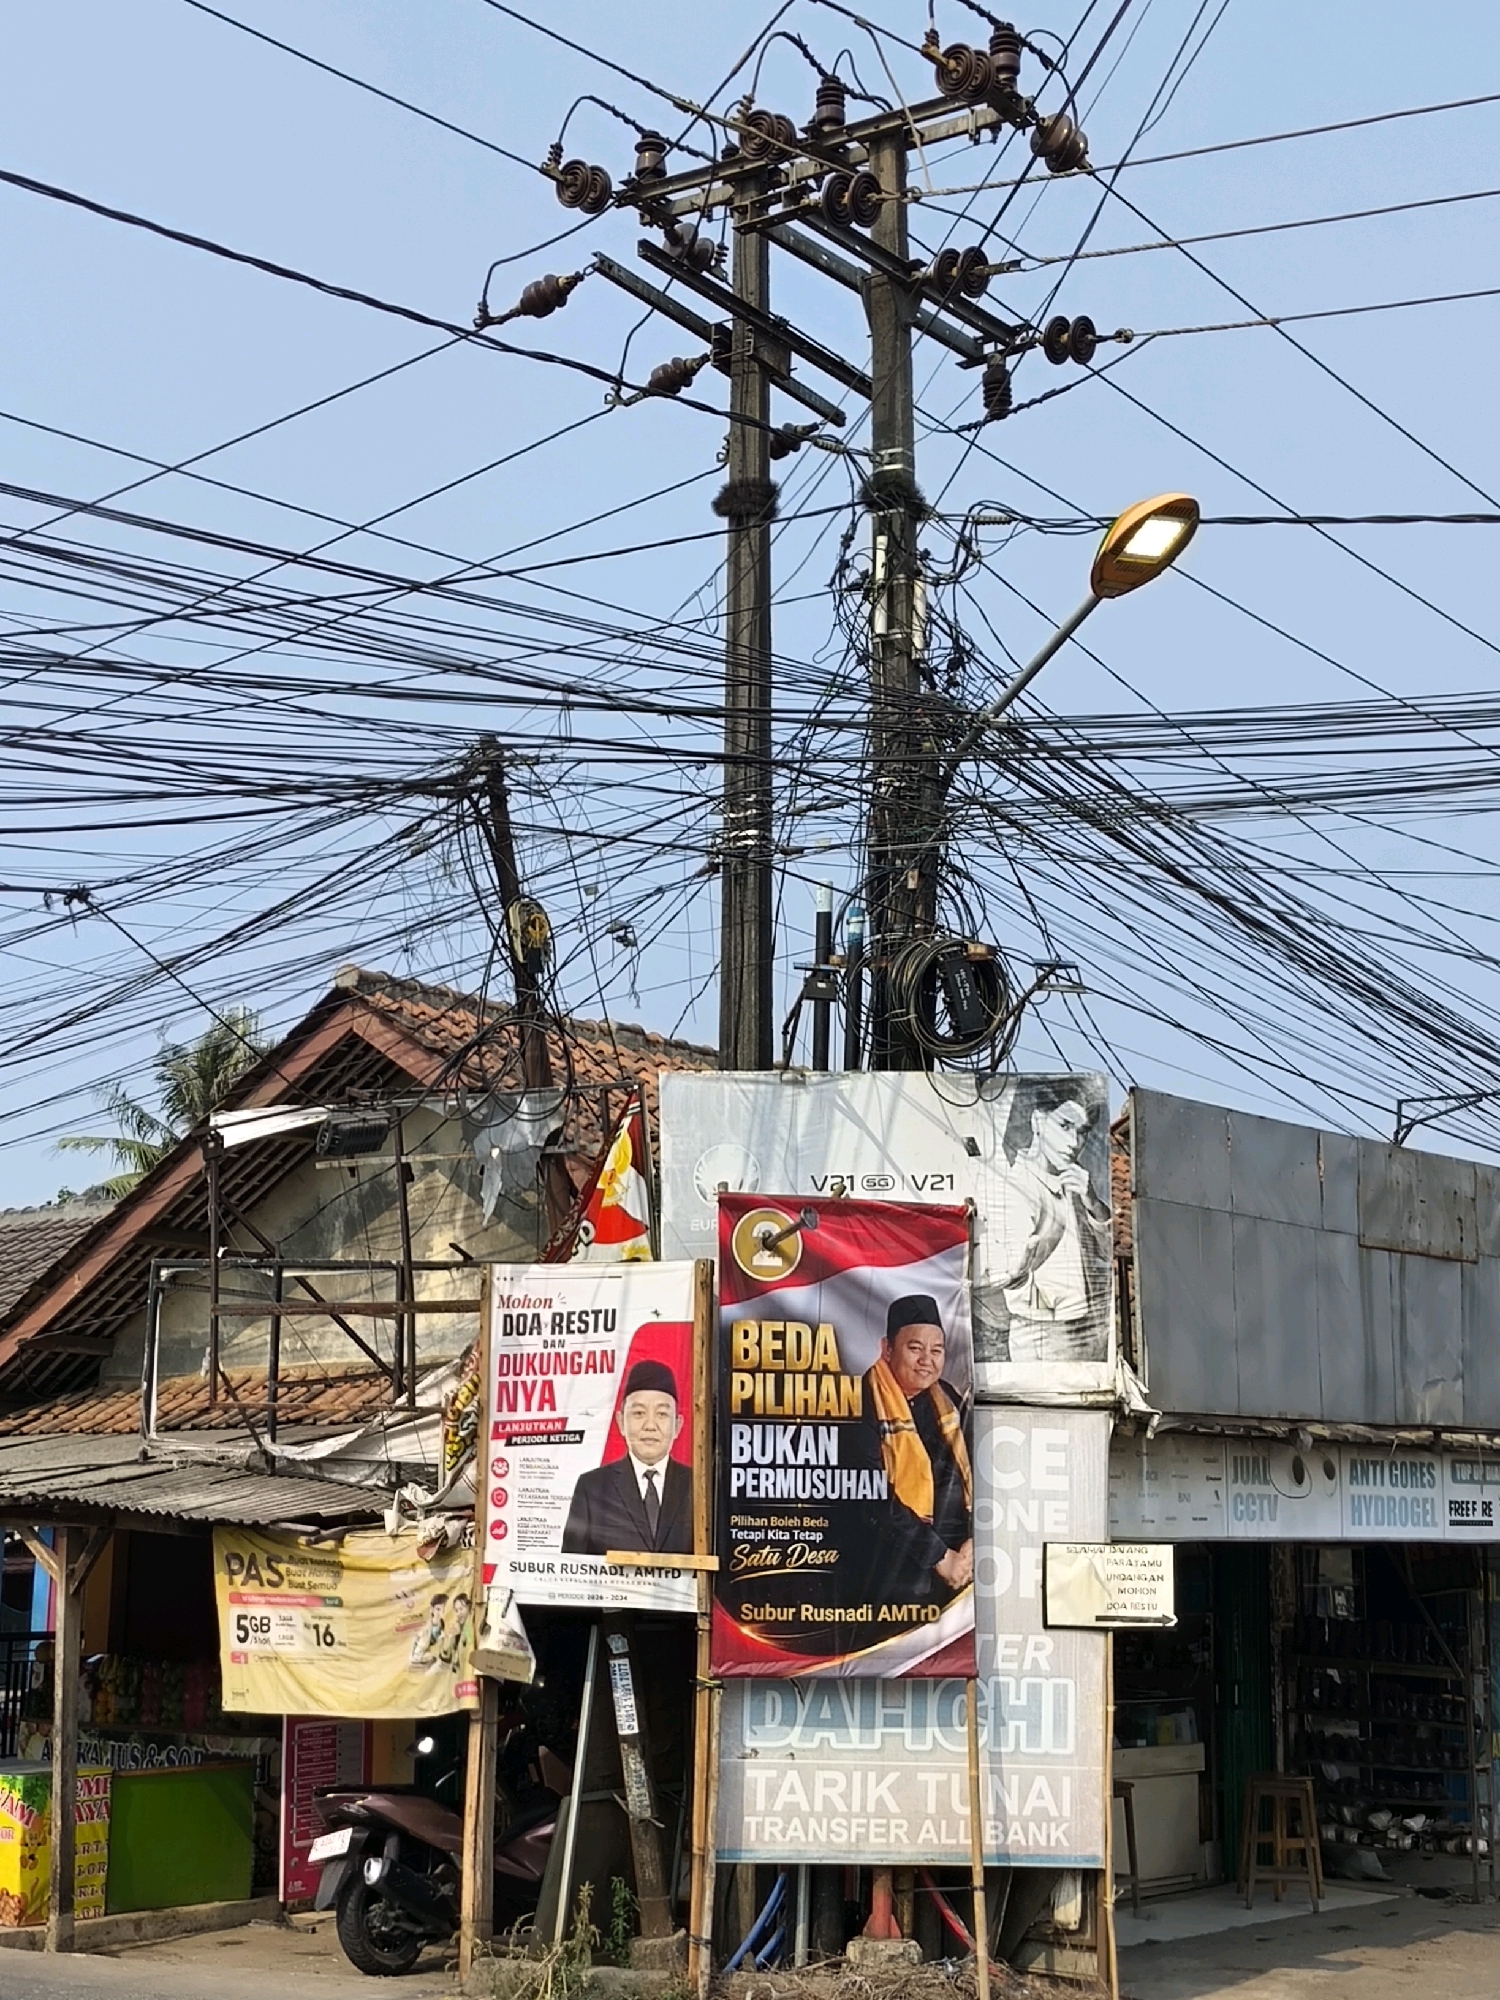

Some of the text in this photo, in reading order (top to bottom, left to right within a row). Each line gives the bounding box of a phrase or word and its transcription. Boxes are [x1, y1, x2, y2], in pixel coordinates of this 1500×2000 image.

[911, 1174, 954, 1191] V21
[497, 1294, 554, 1310] Mohon
[502, 1308, 617, 1336] DOA RESTU
[542, 1339, 566, 1349] DAN
[731, 1320, 841, 1372] BEDA
[498, 1349, 616, 1377] DUKUNGAN
[496, 1379, 556, 1412] NYA
[731, 1372, 863, 1417] PILIHAN
[498, 1421, 562, 1432] LANJUTKAN
[511, 1432, 581, 1444] PERIODE KETIGA
[731, 1424, 839, 1466] BUKAN
[730, 1467, 888, 1500] PERMUSUHAN
[1232, 1456, 1270, 1485] JUAL
[1350, 1459, 1436, 1489] ANTI GORES
[730, 1515, 828, 1527] Pilihan Boleh Beda
[1233, 1493, 1278, 1521] CCTV
[1351, 1494, 1438, 1528] HYDROGEL
[1449, 1499, 1493, 1517] FREE FRE
[730, 1529, 823, 1542] Tetapi Kita Tetap
[225, 1552, 284, 1588] PAS
[509, 1561, 555, 1573] SUBUR
[560, 1563, 629, 1578] RUSNADI,
[634, 1566, 681, 1579] AMTrD
[730, 1543, 839, 1571] Satu Desa
[740, 1603, 940, 1621] Subur Rusnadi AMTrD
[312, 1623, 335, 1647] 16
[745, 1769, 1071, 1818] TARIK TUNAI
[0, 1829, 14, 1840] OR
[745, 1816, 1070, 1847] TRANSFER ALL BANK
